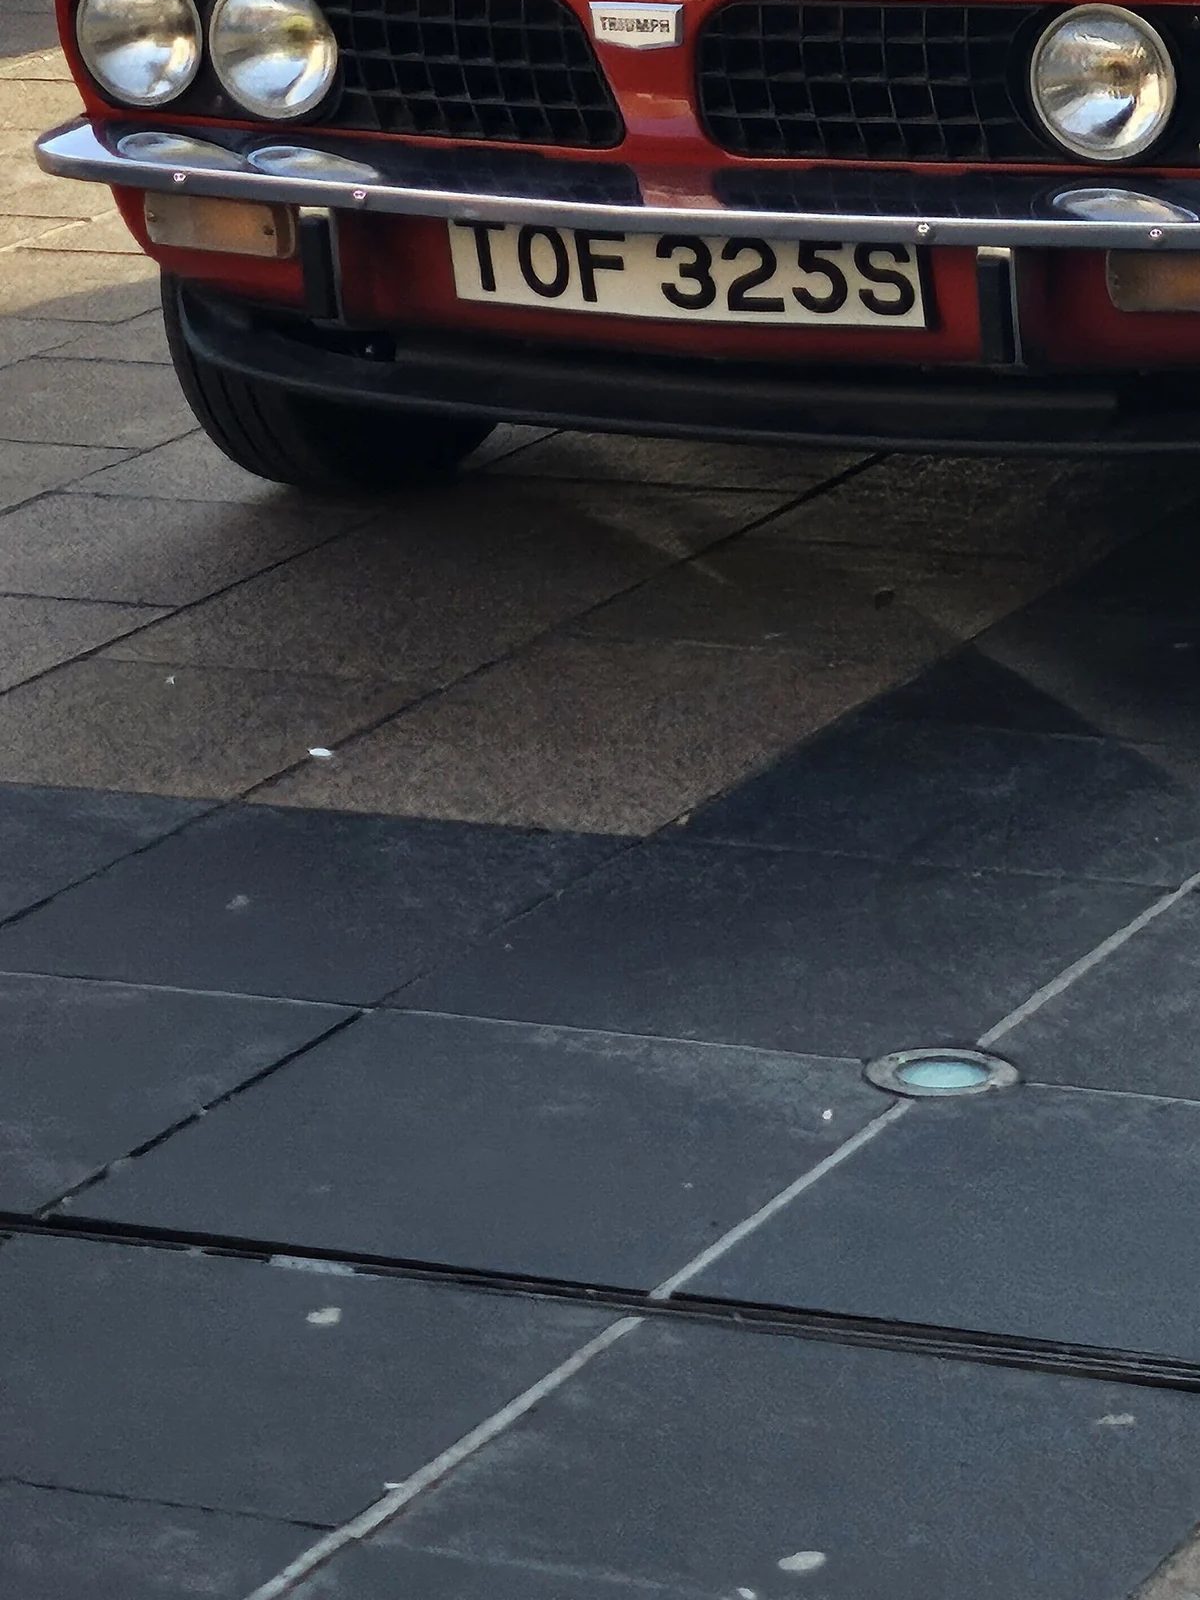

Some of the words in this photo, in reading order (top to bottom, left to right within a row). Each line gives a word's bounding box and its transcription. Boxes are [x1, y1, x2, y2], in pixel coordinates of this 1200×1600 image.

[600, 16, 670, 33] TRIUMPH
[454, 220, 626, 303] TOF
[655, 234, 916, 316] 325S
